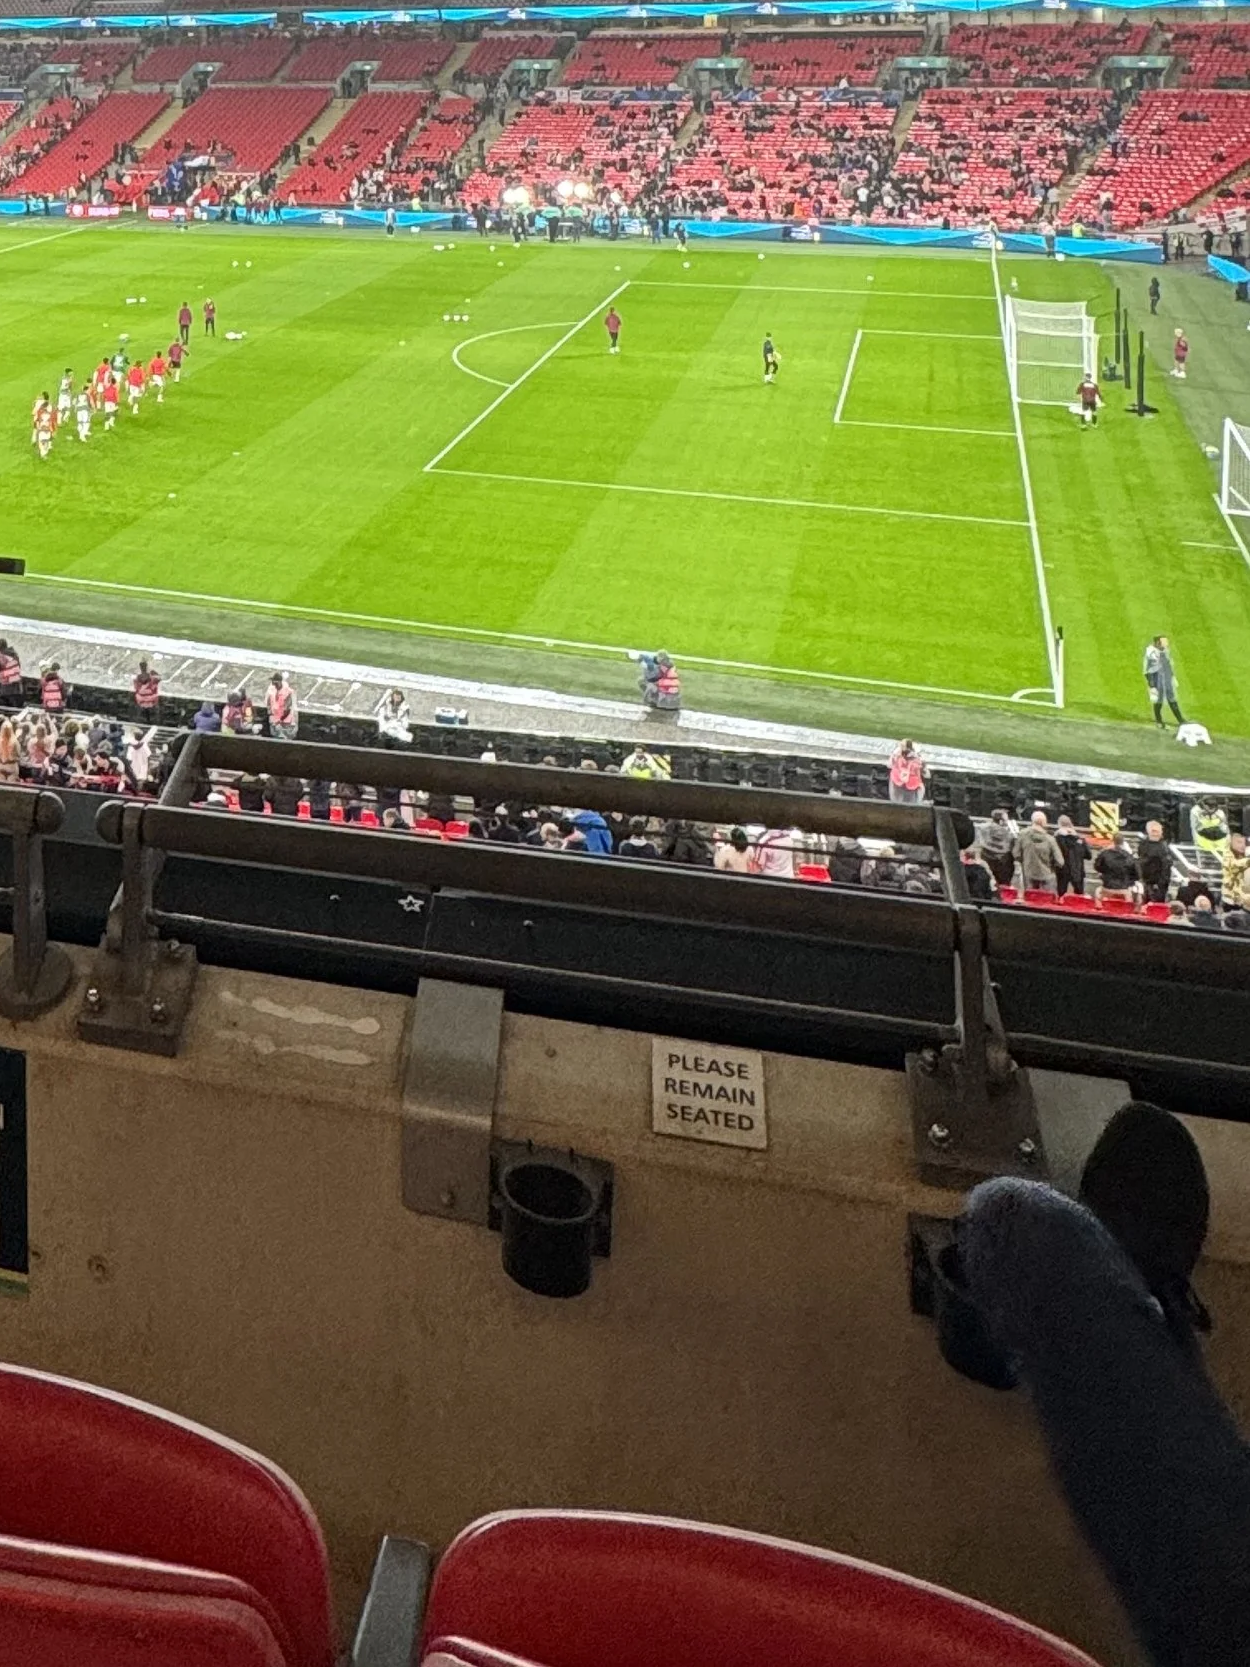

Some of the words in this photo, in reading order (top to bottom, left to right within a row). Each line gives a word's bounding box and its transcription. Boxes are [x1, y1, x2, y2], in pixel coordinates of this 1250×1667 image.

[668, 1053, 750, 1079] PLEASE
[664, 1078, 755, 1106] REMAIN
[666, 1103, 754, 1131] SEATED
